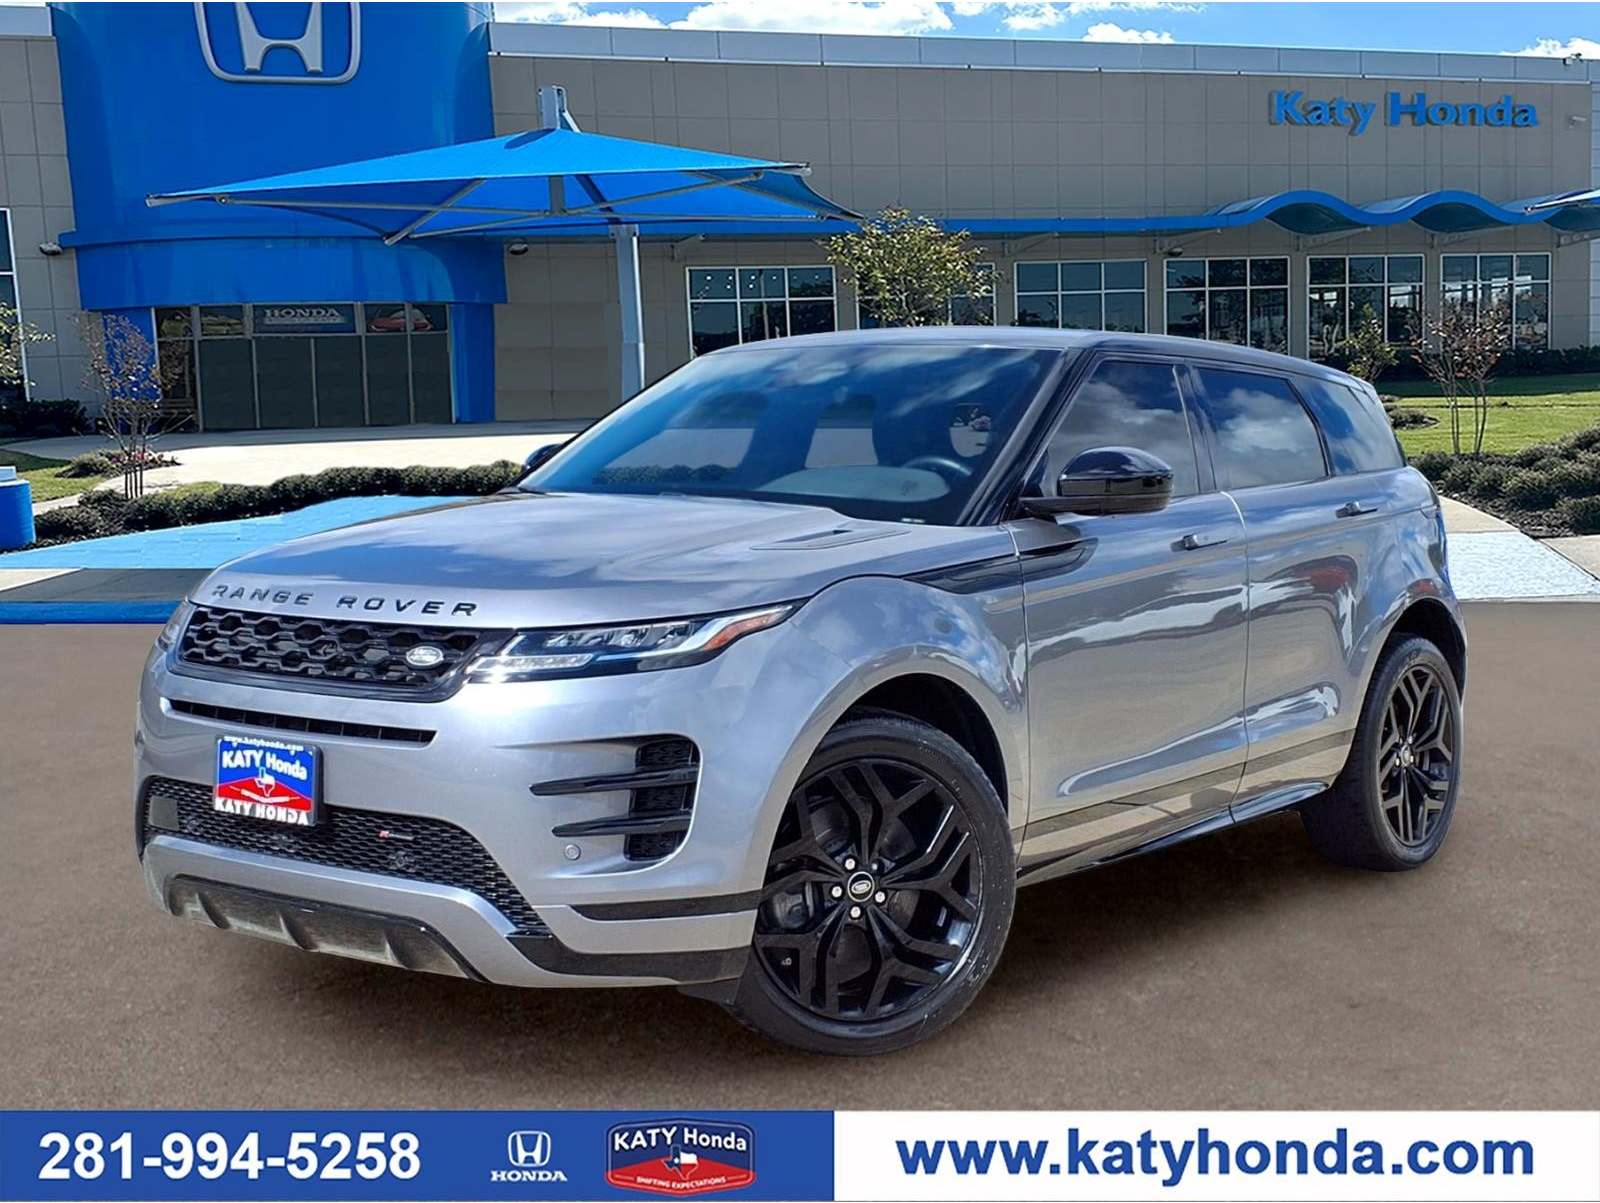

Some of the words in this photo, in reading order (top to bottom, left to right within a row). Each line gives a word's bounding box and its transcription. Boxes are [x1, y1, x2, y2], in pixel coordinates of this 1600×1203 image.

[1269, 90, 1376, 136] Katy
[1385, 91, 1539, 127] Honda
[264, 308, 341, 318] HONDA
[211, 585, 313, 606] RANGE
[336, 597, 478, 617] ROVER
[222, 749, 264, 769] KATY
[265, 750, 308, 781] Honda
[214, 796, 254, 816] KATY
[255, 802, 309, 826] HONDA
